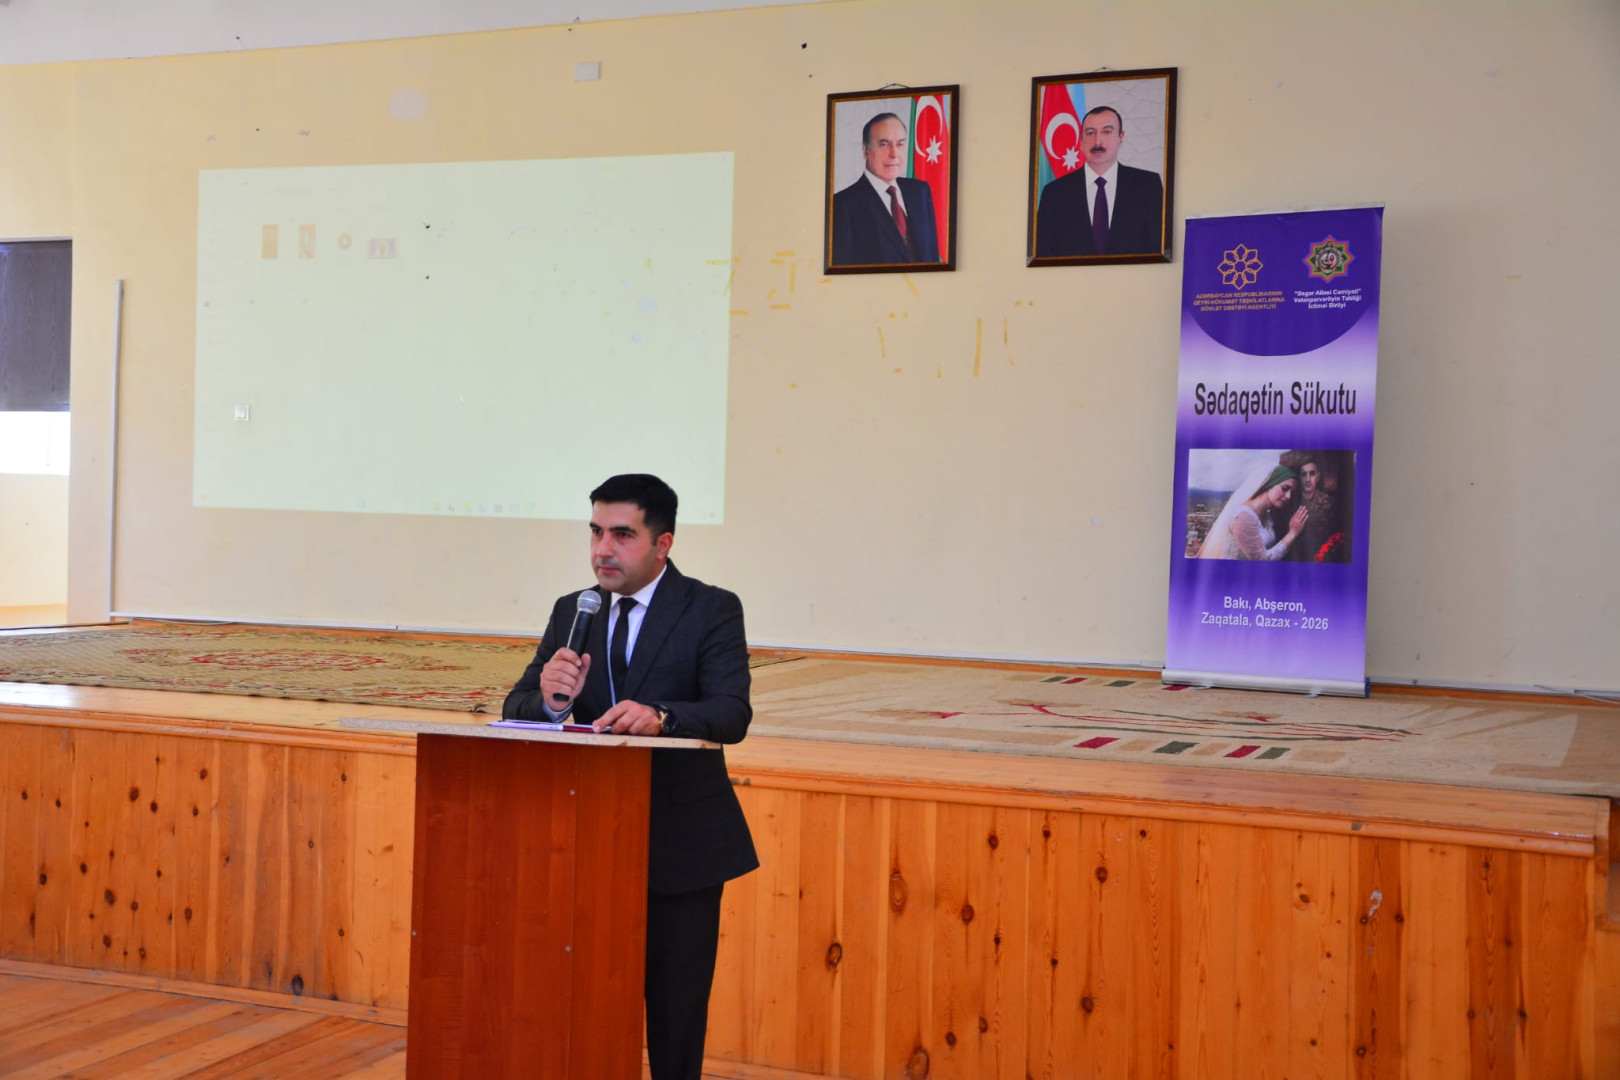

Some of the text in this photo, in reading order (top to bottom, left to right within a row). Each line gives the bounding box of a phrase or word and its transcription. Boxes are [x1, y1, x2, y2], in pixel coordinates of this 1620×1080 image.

[1194, 381, 1357, 423] Sədaqətin Sükutu
[1223, 596, 1307, 614] Bakı, Abşeron,
[1201, 611, 1252, 627] Zaqatala,
[1255, 614, 1291, 628] Qazax
[1301, 616, 1329, 630] 2026
